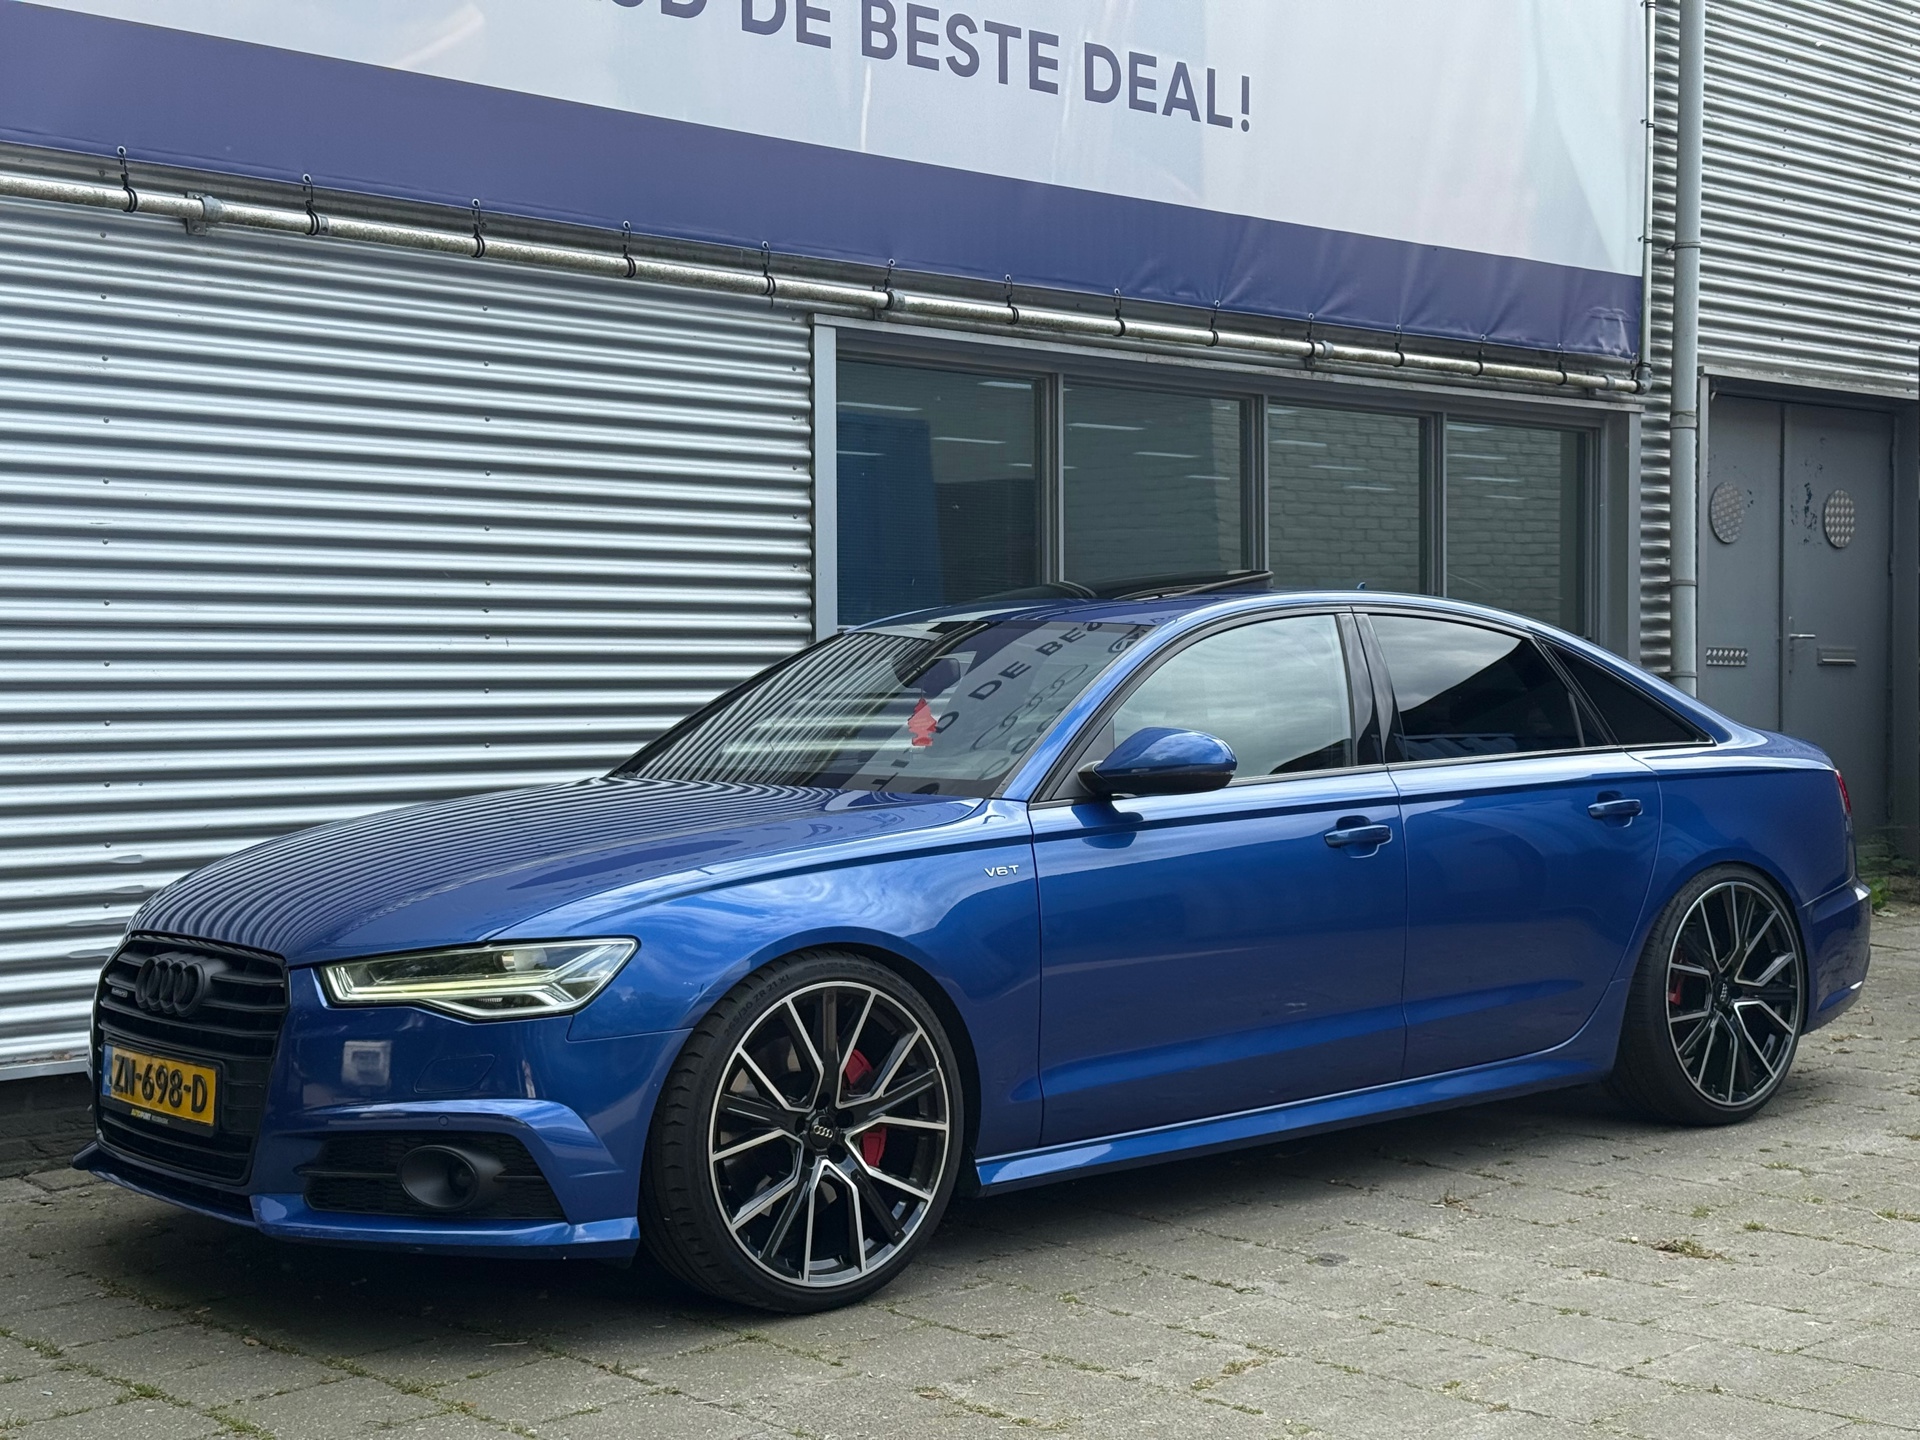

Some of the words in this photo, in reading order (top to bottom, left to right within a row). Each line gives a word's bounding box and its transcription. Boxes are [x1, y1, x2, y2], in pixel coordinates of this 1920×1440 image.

[861, 0, 1059, 95] BESTE
[1084, 41, 1250, 132] DEAL!
[984, 865, 1019, 877] V6T
[113, 1054, 208, 1113] ZN-698-D
